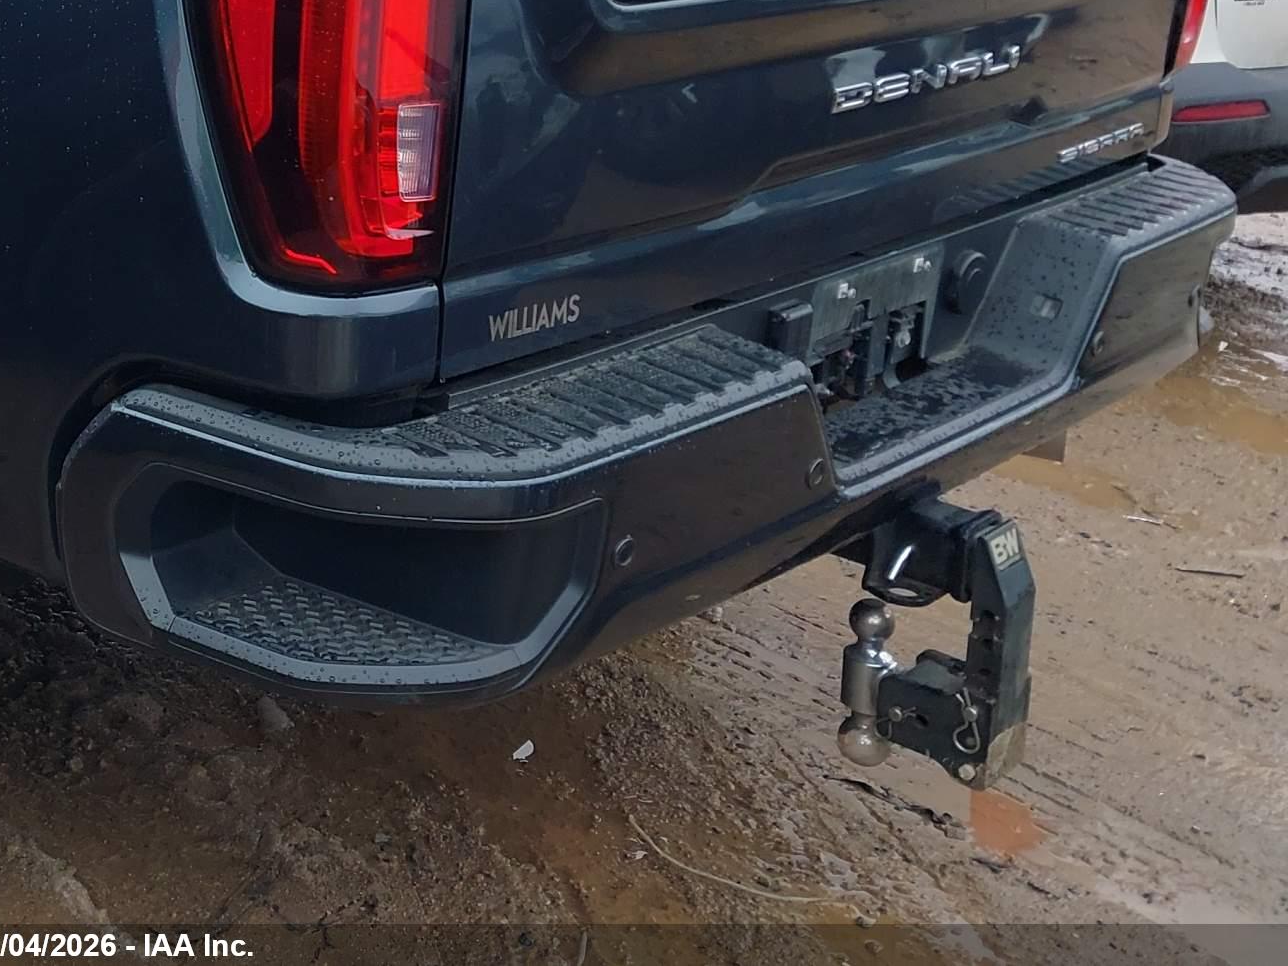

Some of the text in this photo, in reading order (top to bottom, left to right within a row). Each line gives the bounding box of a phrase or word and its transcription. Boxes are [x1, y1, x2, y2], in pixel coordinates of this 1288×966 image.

[831, 45, 1020, 114] DENALI
[1057, 122, 1144, 164] SIERRA
[488, 294, 581, 342] WILLIAMS
